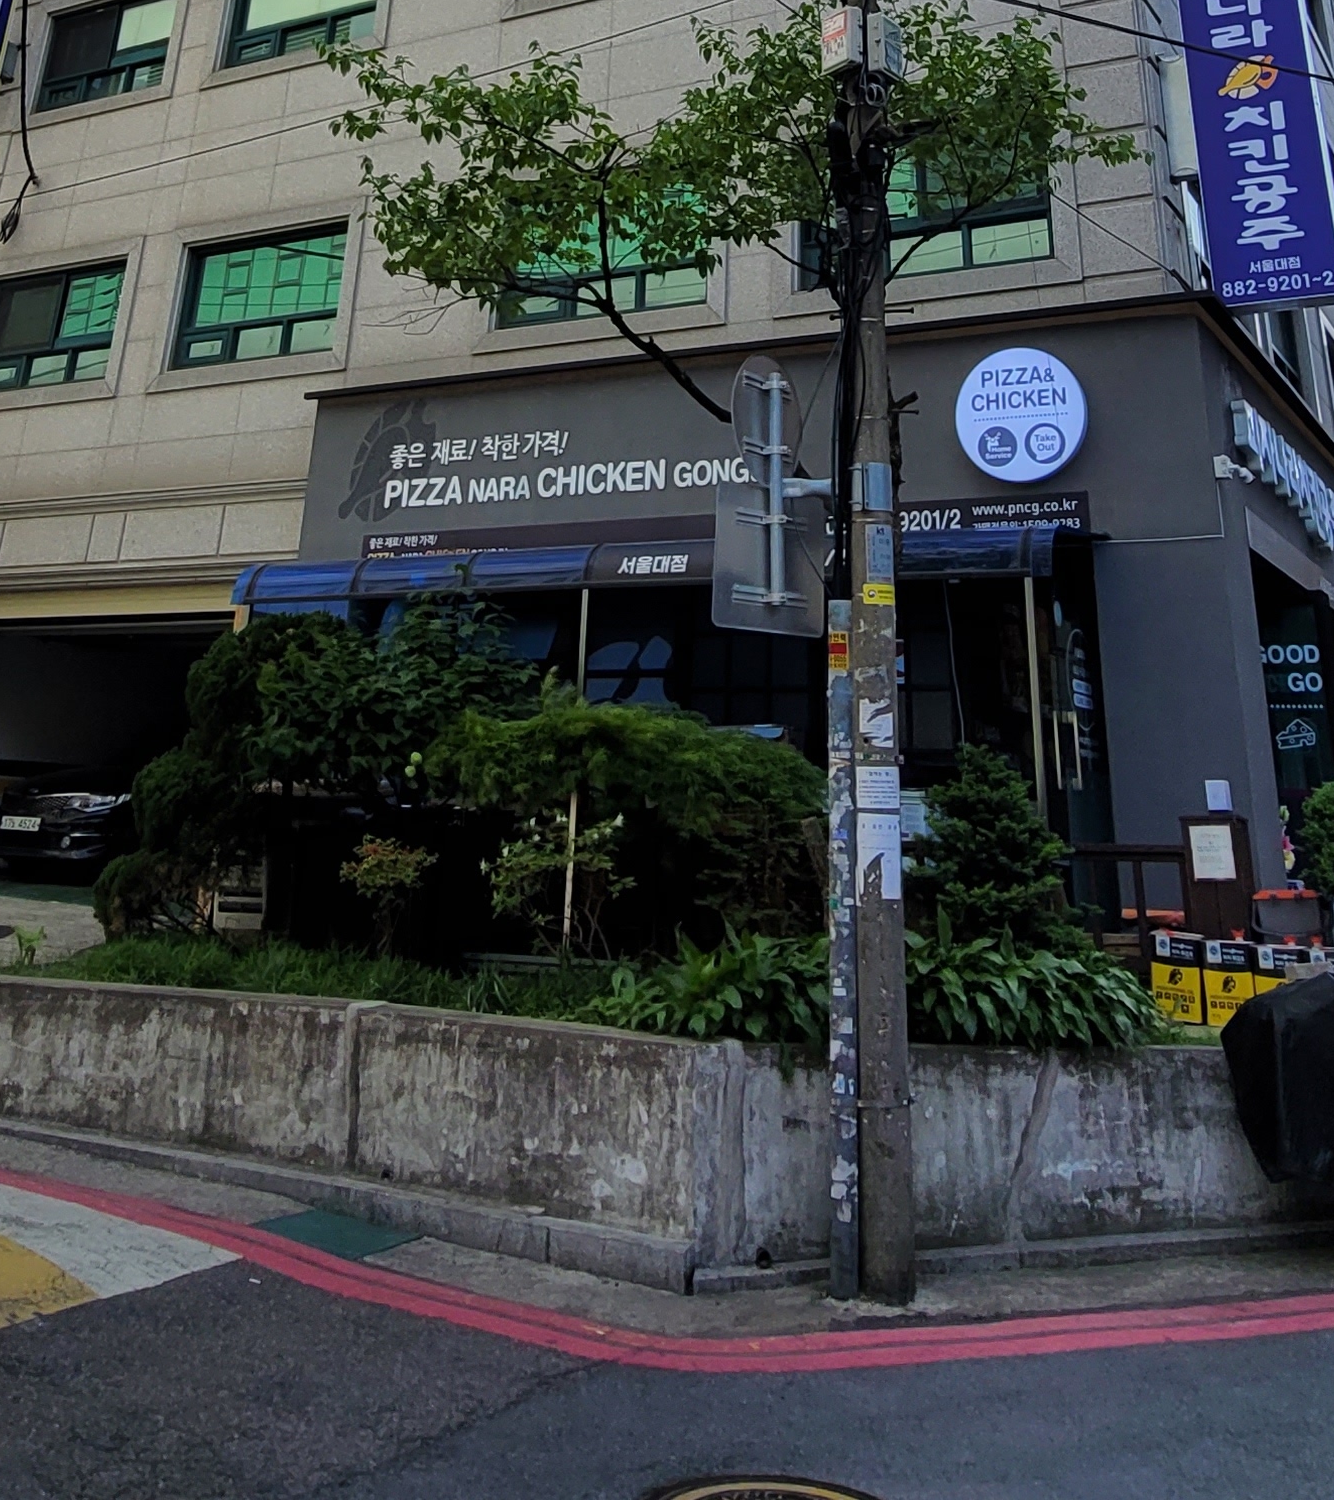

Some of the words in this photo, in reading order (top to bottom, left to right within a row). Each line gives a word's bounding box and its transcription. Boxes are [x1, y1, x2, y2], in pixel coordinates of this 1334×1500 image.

[1223, 100, 1305, 252] 치킨공주
[1247, 255, 1302, 275] 서울대점
[970, 387, 1068, 413] CHICKEN
[1033, 434, 1057, 443] Take
[1036, 442, 1056, 452] Out
[389, 441, 428, 471] 좋은
[430, 438, 478, 465] 재료!
[480, 434, 522, 463] 착한
[522, 429, 570, 460] 가격!
[383, 474, 463, 510] PIZZA
[467, 474, 532, 504] NARA
[536, 458, 667, 499] CHICKEN
[672, 456, 760, 489] GONG
[971, 497, 1079, 518] www.pncg.co.kr
[616, 553, 690, 577] 서울대점
[1287, 672, 1323, 693] GO
